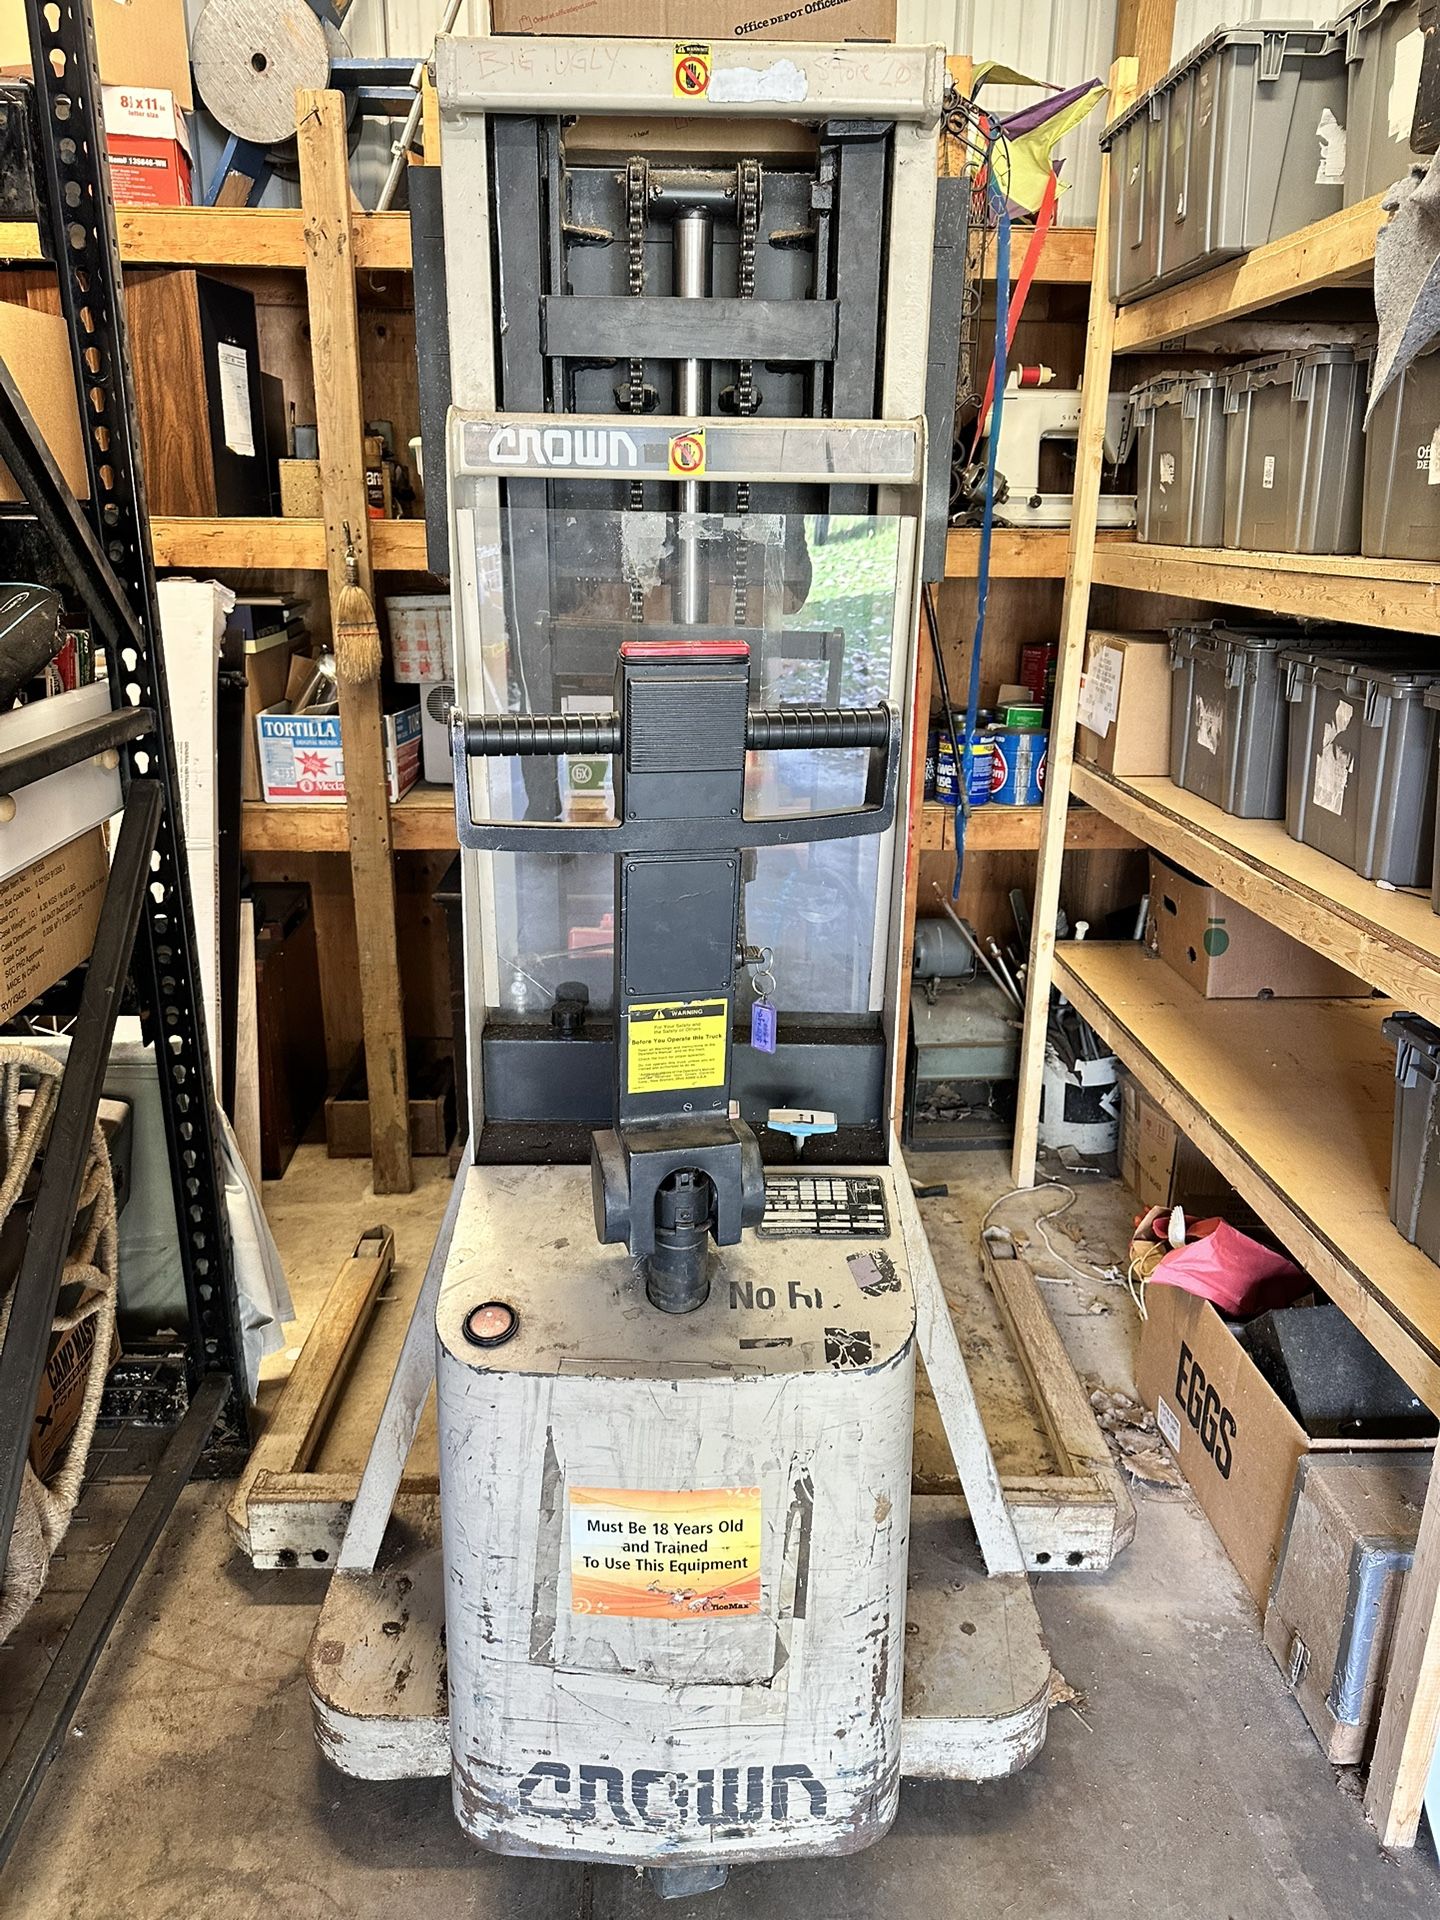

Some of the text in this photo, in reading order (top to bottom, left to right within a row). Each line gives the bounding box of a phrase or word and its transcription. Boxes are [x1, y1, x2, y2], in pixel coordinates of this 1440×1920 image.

[734, 18, 770, 37] Office
[769, 8, 803, 26] DEPOT
[479, 47, 621, 81] BIG UGLY
[136, 98, 144, 109] x
[145, 97, 158, 111] 11
[488, 428, 638, 467] CROWN
[264, 720, 337, 738] TORTILLA
[0, 940, 13, 954] Case
[2, 953, 15, 967] Case
[6, 974, 22, 992] MADE
[26, 960, 41, 978] CHINA
[671, 1008, 704, 1017] WARNING
[631, 1038, 652, 1046] Before
[653, 1037, 666, 1045] You
[666, 1035, 691, 1045] Operate
[705, 1033, 722, 1041] Truck
[728, 1280, 777, 1311] No
[45, 1339, 75, 1392] CAMP
[1174, 1338, 1238, 1481] EGGS
[586, 1518, 744, 1536] Must Be 18 Years Old
[621, 1539, 709, 1555] and Trained
[583, 1555, 749, 1575] To Use This Equipment
[517, 1761, 828, 1828] CROWN
